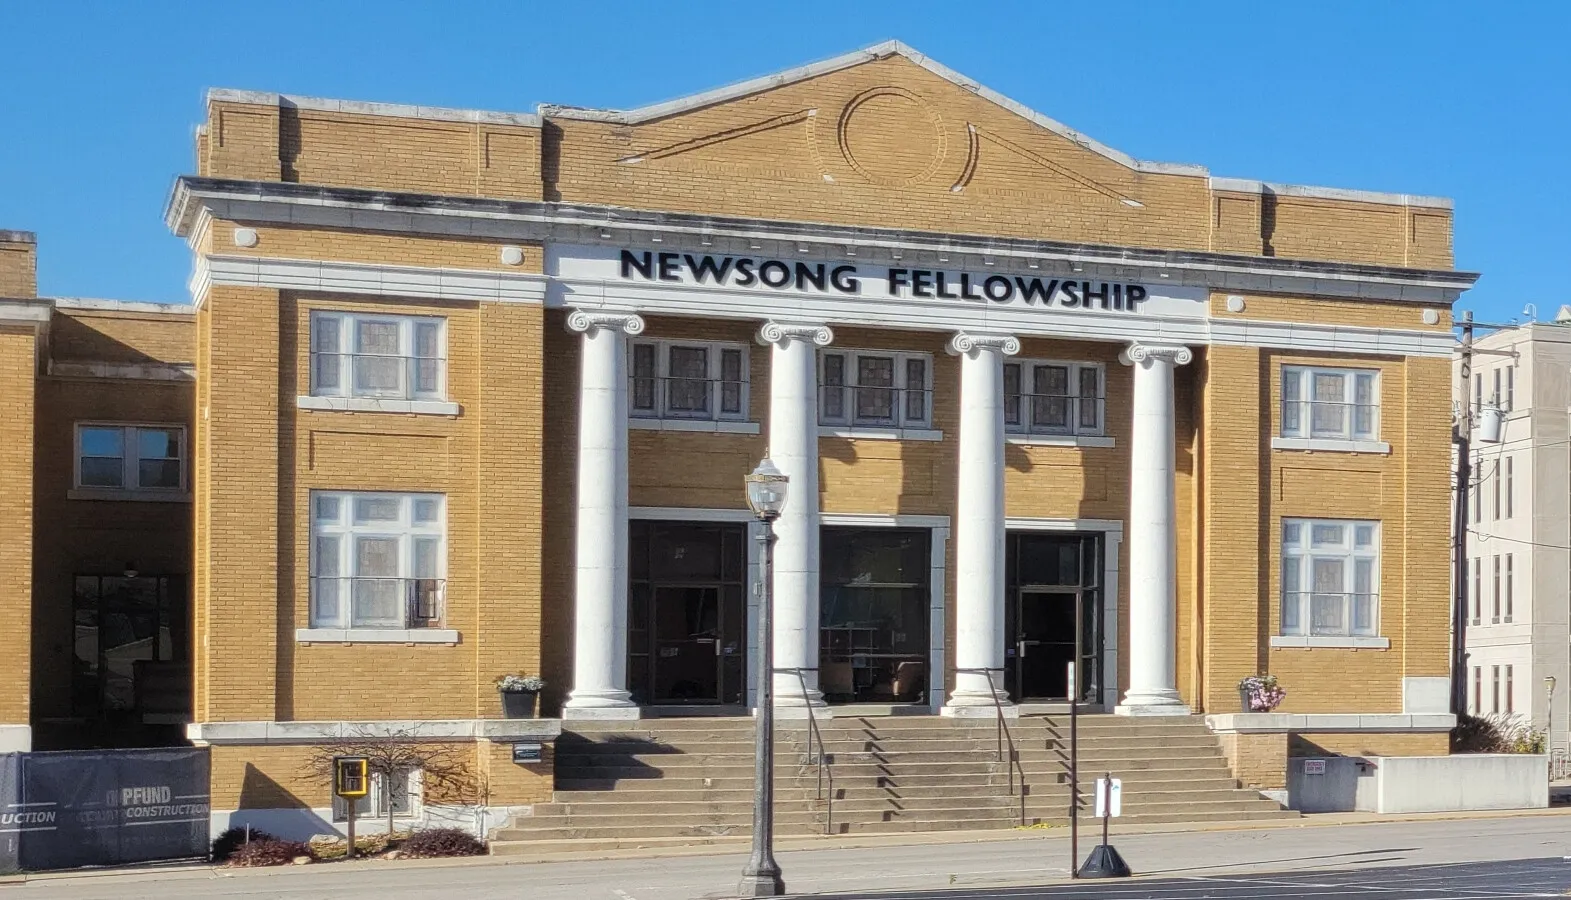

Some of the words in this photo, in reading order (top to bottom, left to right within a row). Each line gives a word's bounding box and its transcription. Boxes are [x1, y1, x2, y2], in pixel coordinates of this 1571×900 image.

[620, 249, 859, 294] NEWSONG
[888, 268, 1148, 312] FELLOWSHIP
[122, 786, 172, 806] PFUND
[126, 804, 208, 818] CONSTRUCTION
